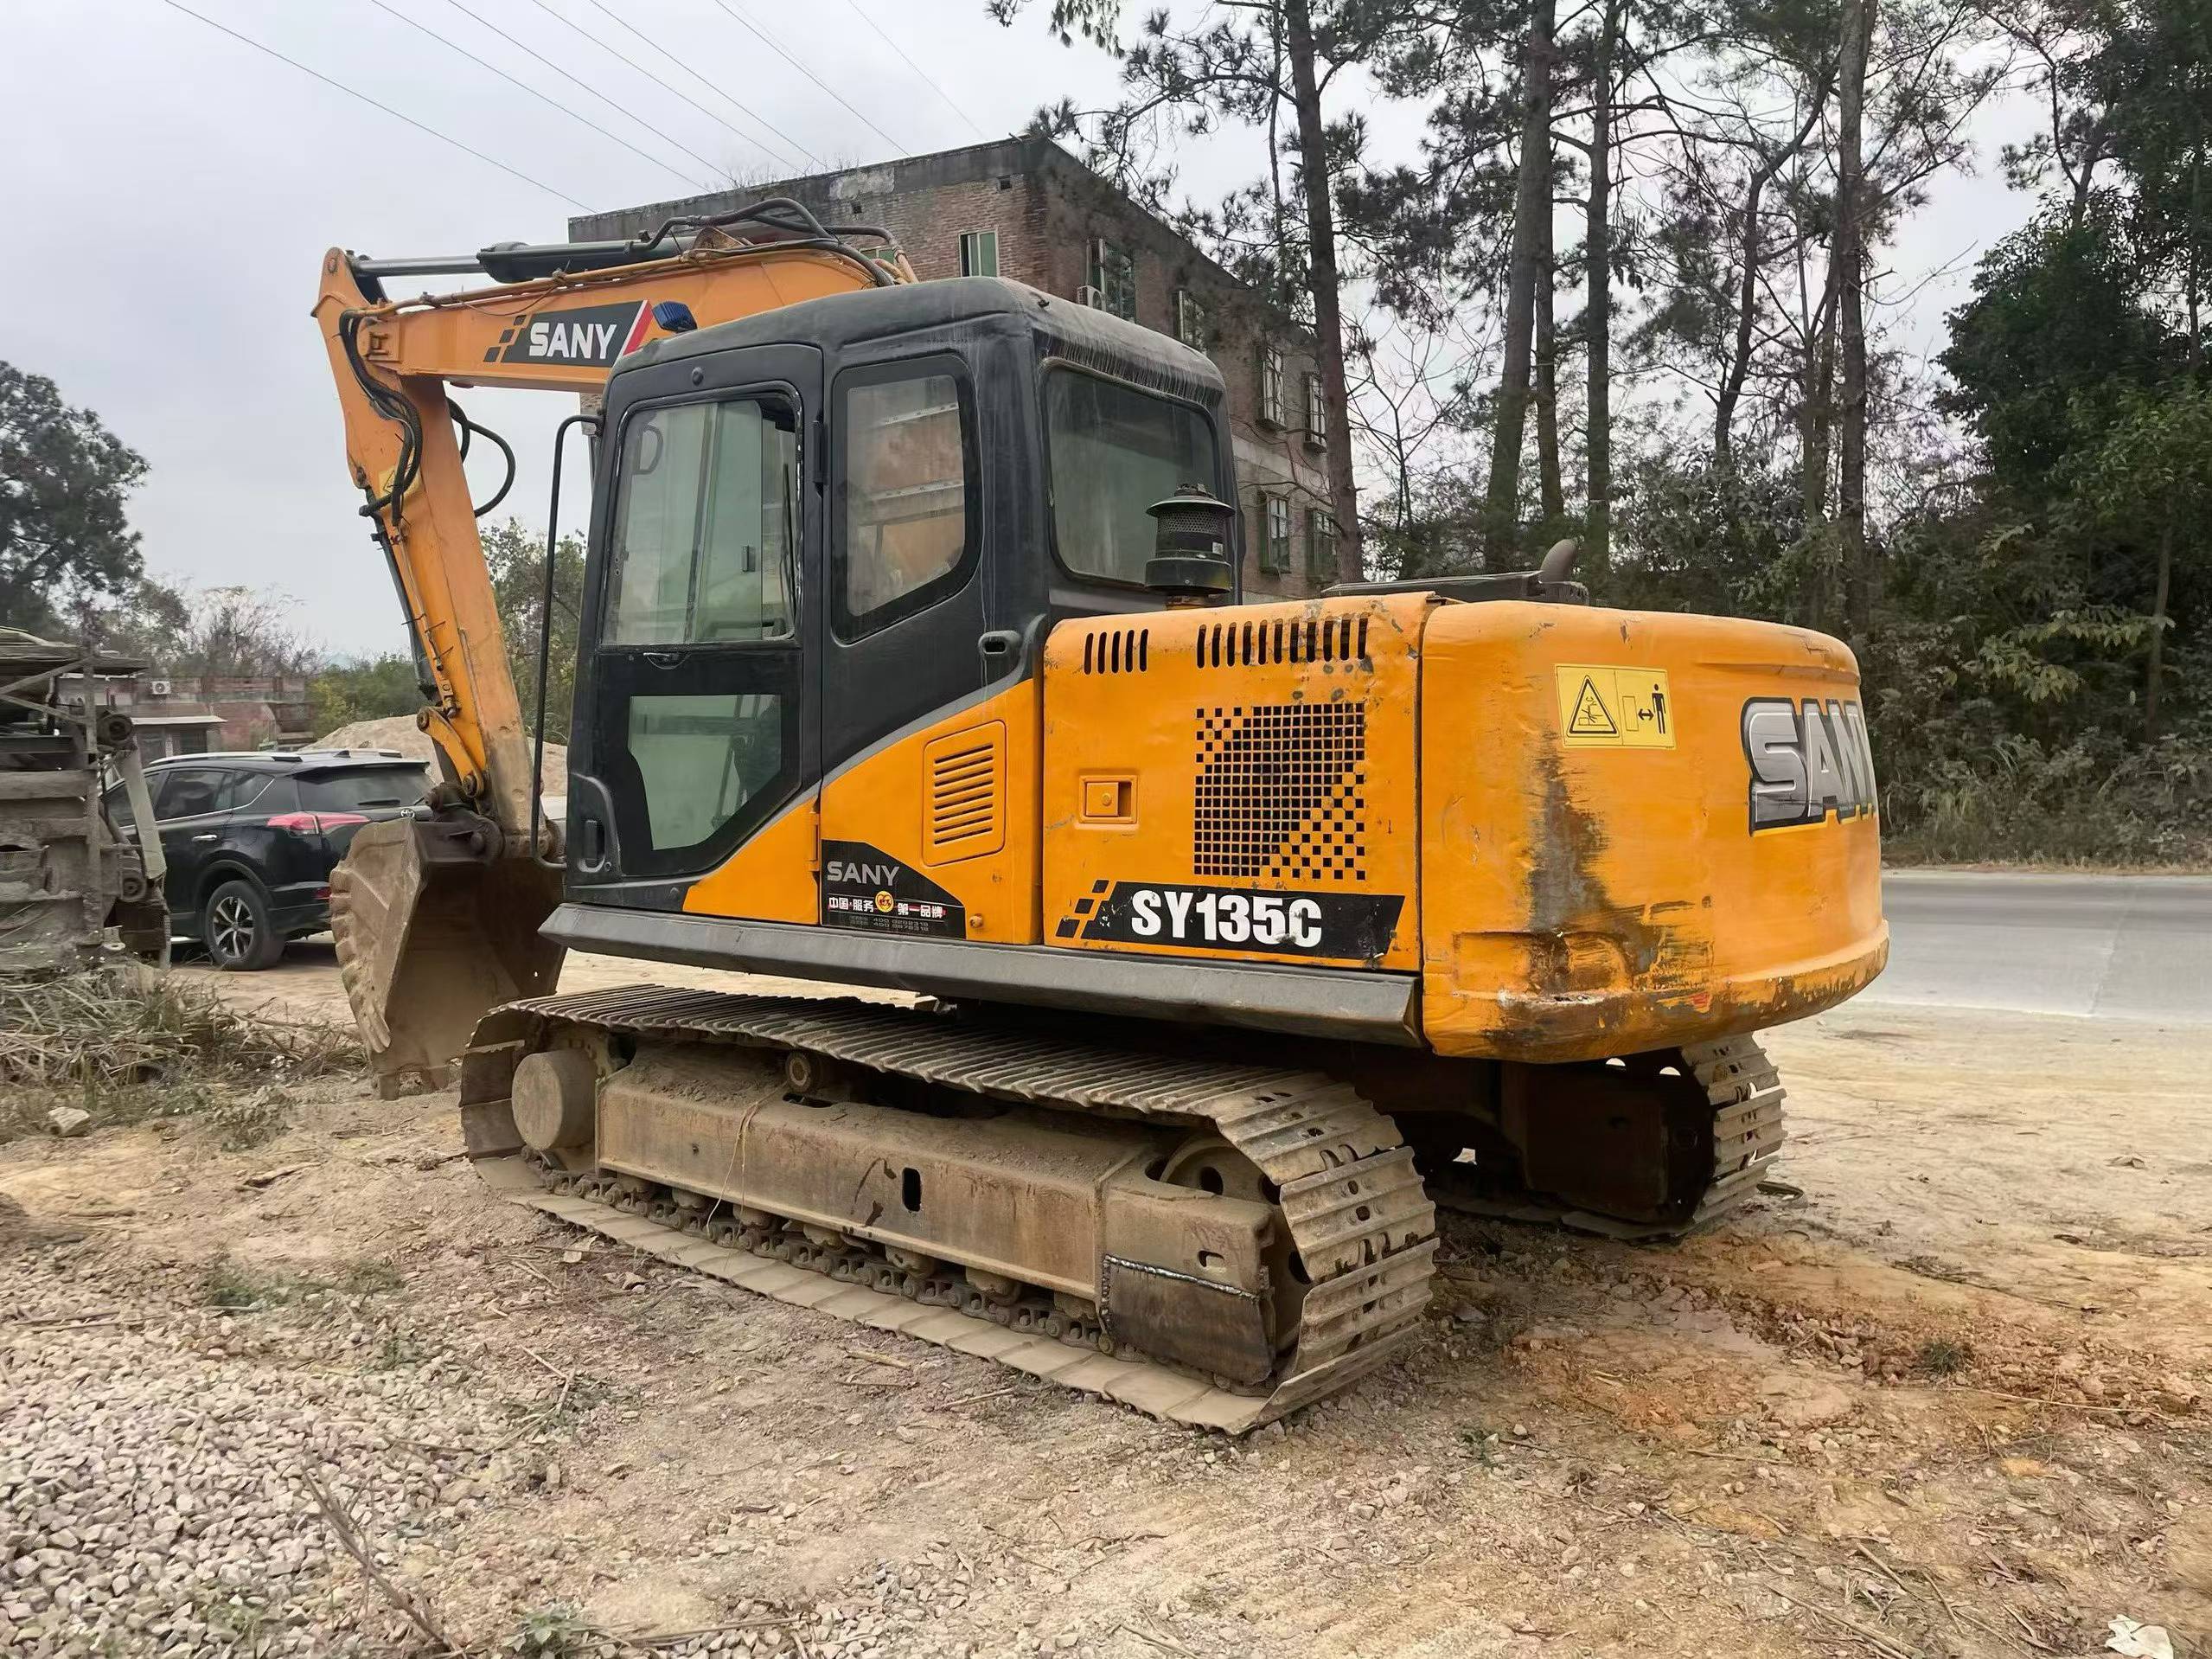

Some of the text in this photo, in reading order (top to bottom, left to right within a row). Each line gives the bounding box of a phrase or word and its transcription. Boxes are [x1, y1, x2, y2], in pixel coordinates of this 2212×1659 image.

[529, 322, 617, 359] SANY
[827, 861, 900, 887] SANY
[1131, 889, 1322, 948] SY135C
